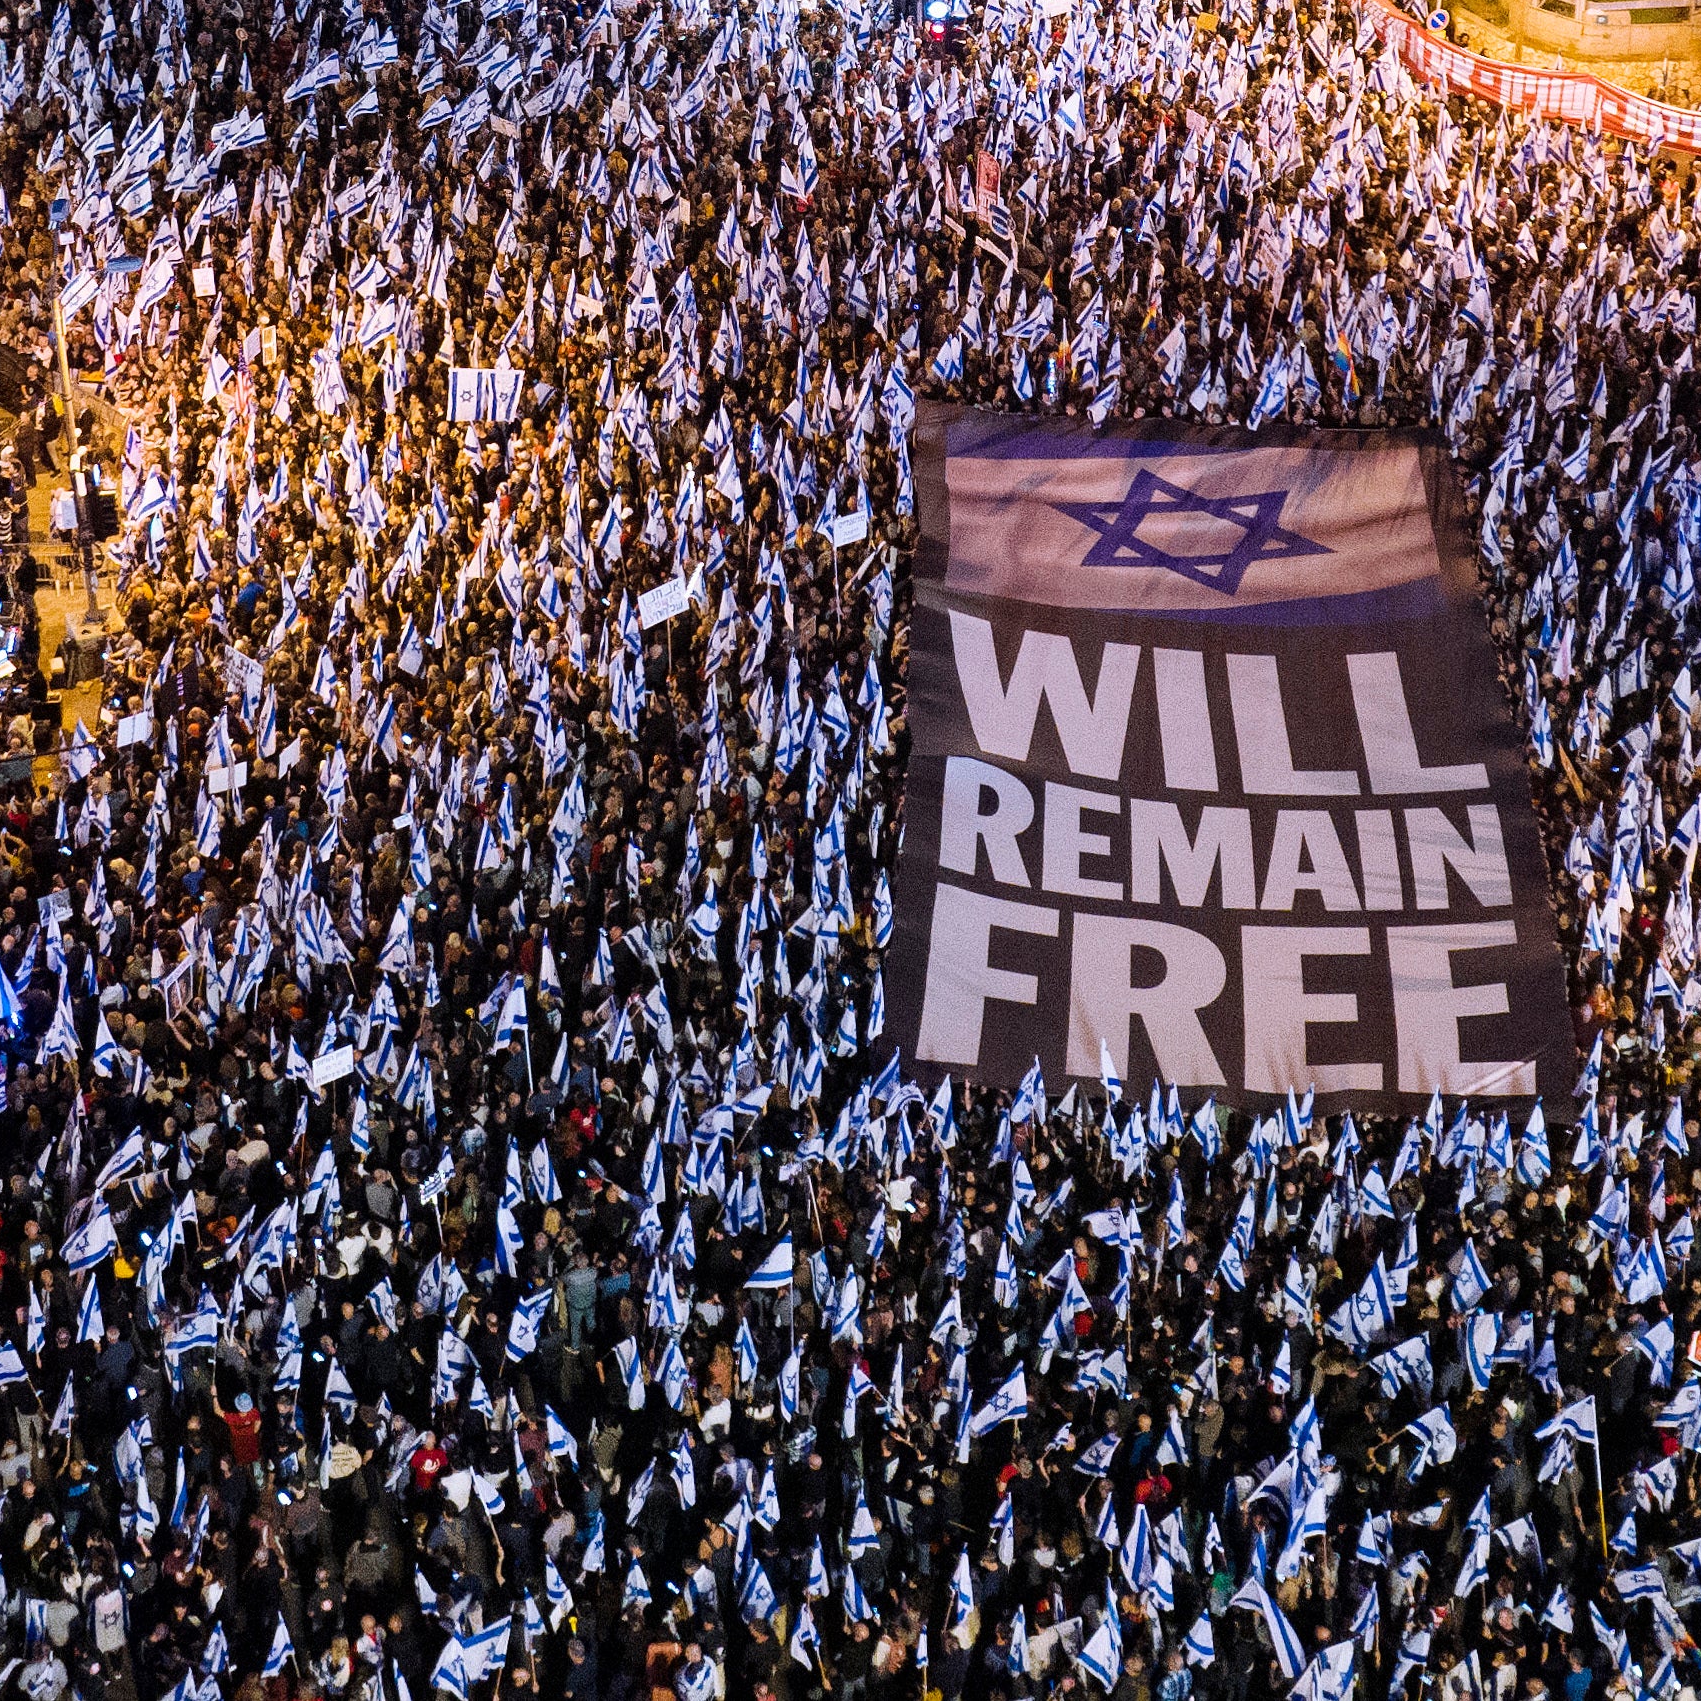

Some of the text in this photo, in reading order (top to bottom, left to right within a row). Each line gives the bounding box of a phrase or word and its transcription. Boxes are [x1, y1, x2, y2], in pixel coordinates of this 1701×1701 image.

[948, 608, 1491, 797] WILL
[938, 755, 1514, 912] REMAIN
[914, 881, 1537, 1096] FREE
